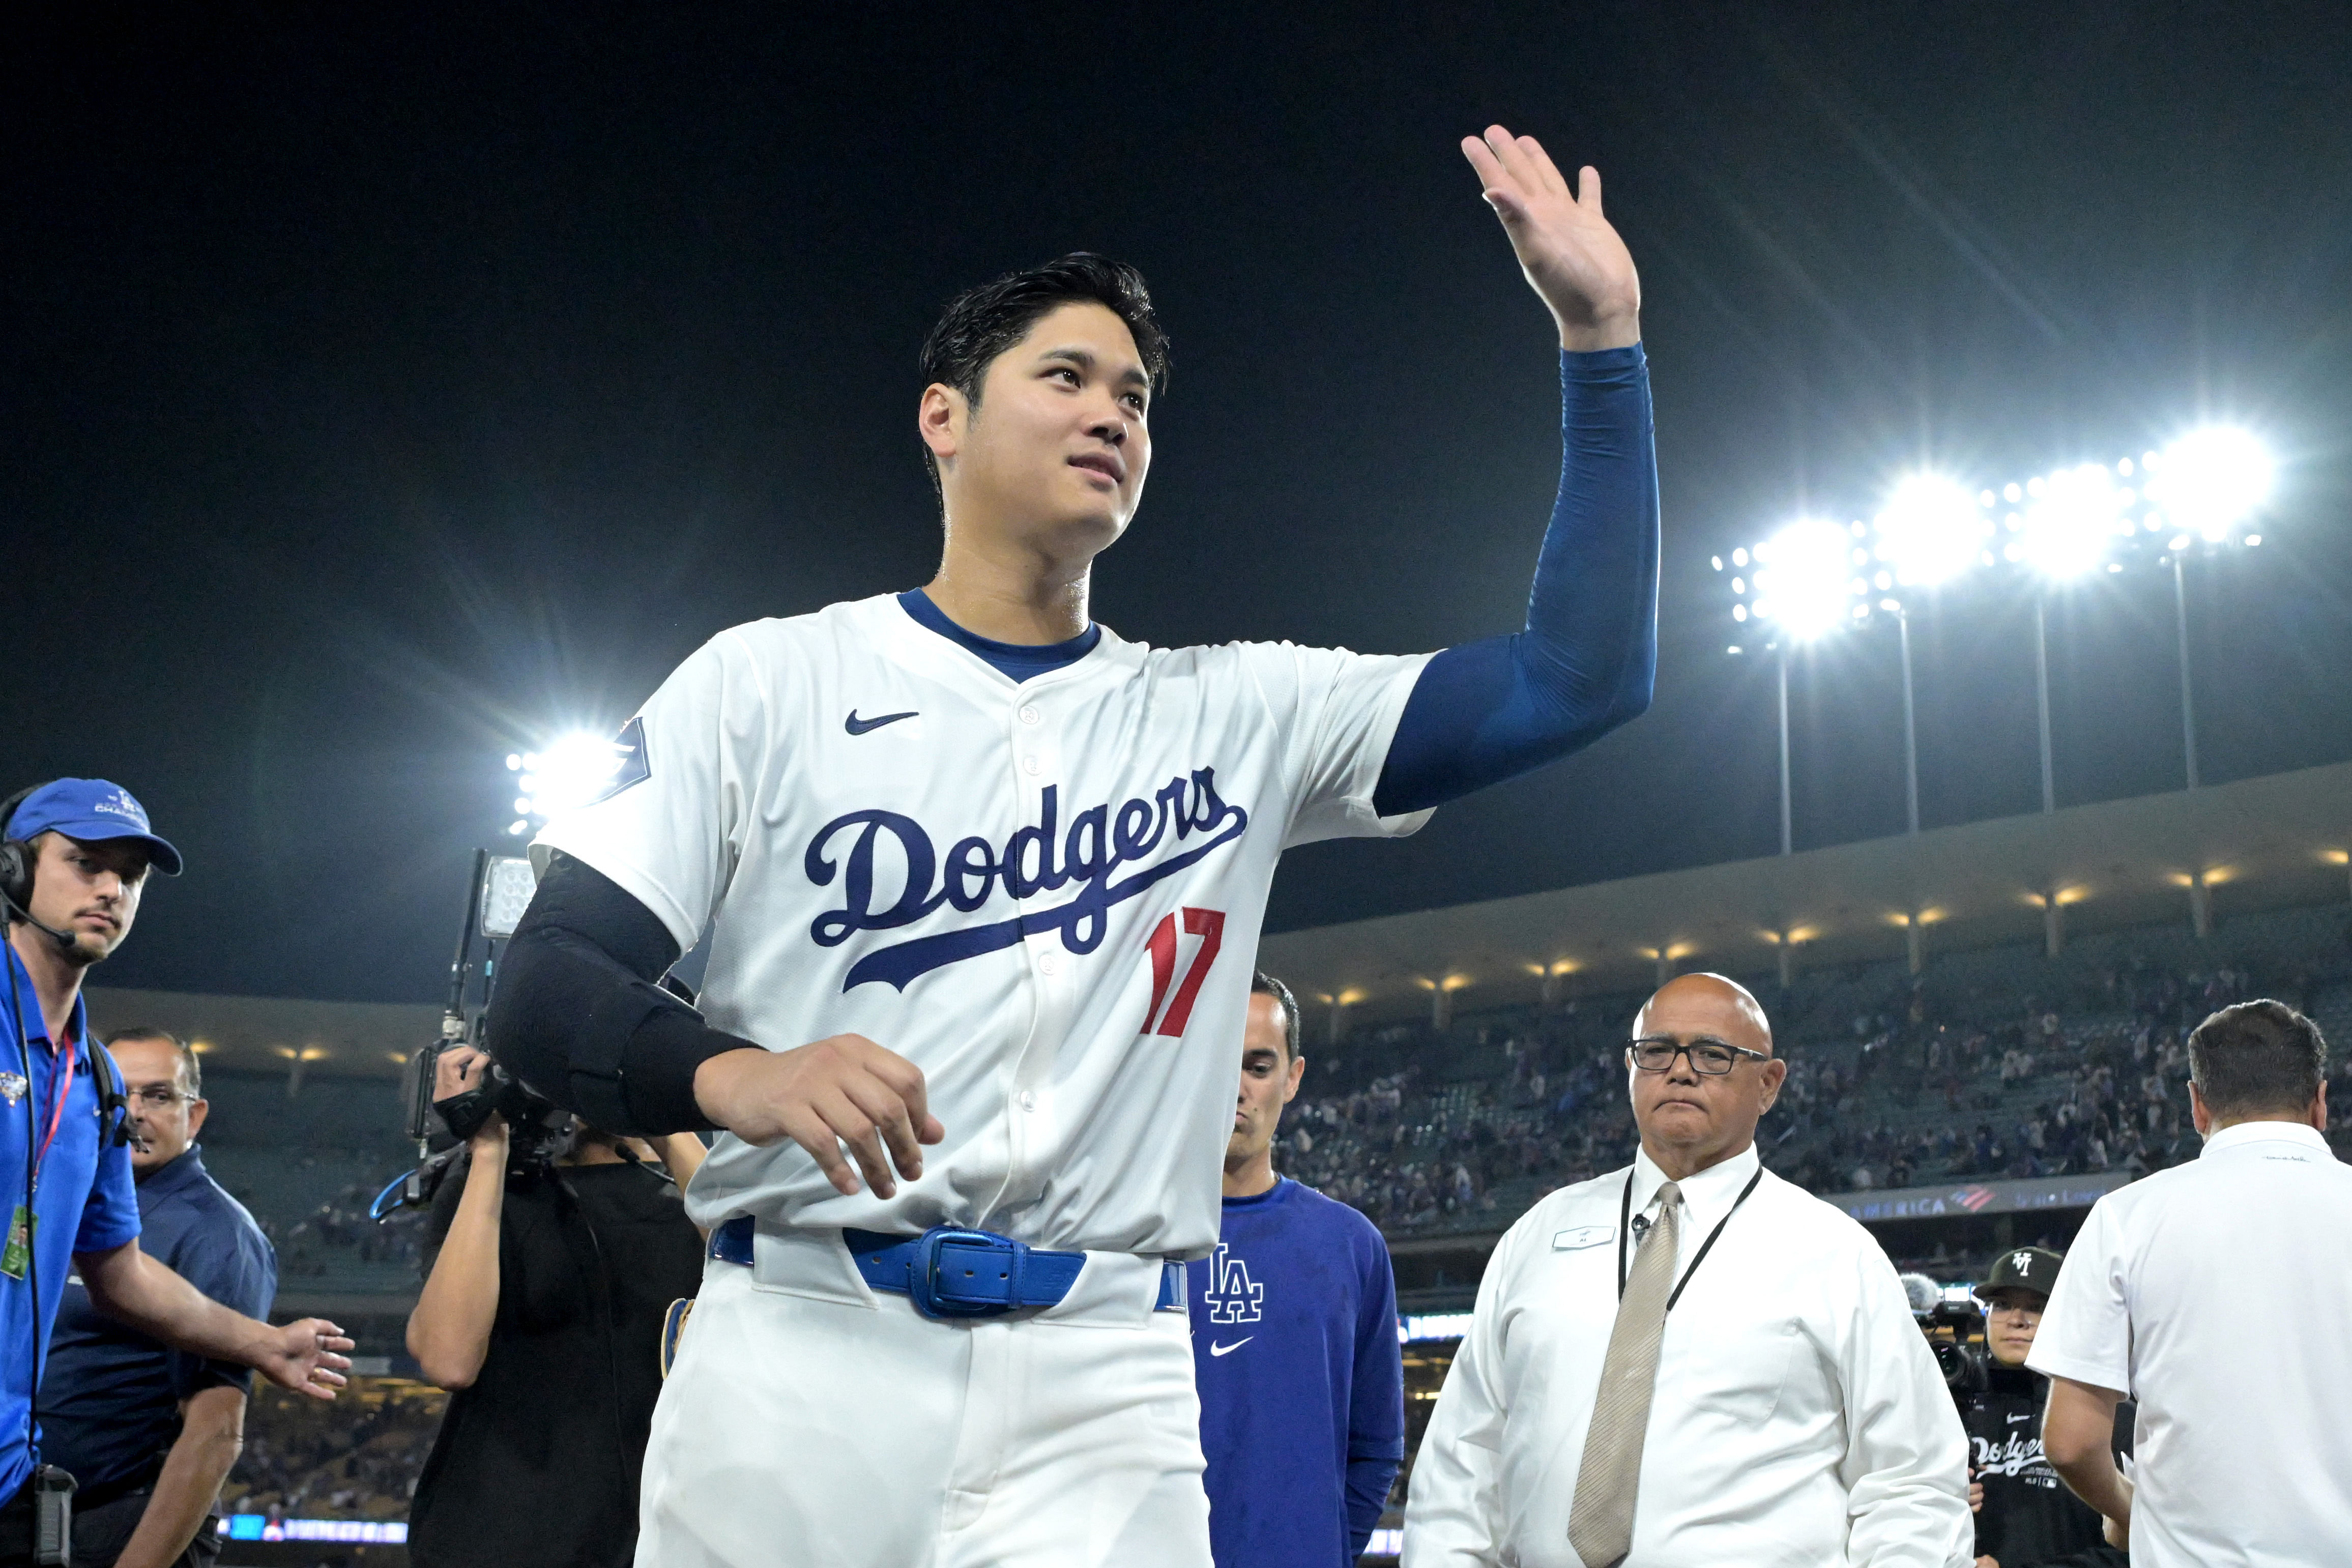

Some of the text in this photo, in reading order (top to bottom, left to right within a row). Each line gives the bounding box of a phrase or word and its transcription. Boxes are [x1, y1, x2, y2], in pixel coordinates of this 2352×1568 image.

[804, 766, 1247, 955] Dodgers
[1140, 906, 1226, 1038] 17
[1205, 1243, 1263, 1323] LA
